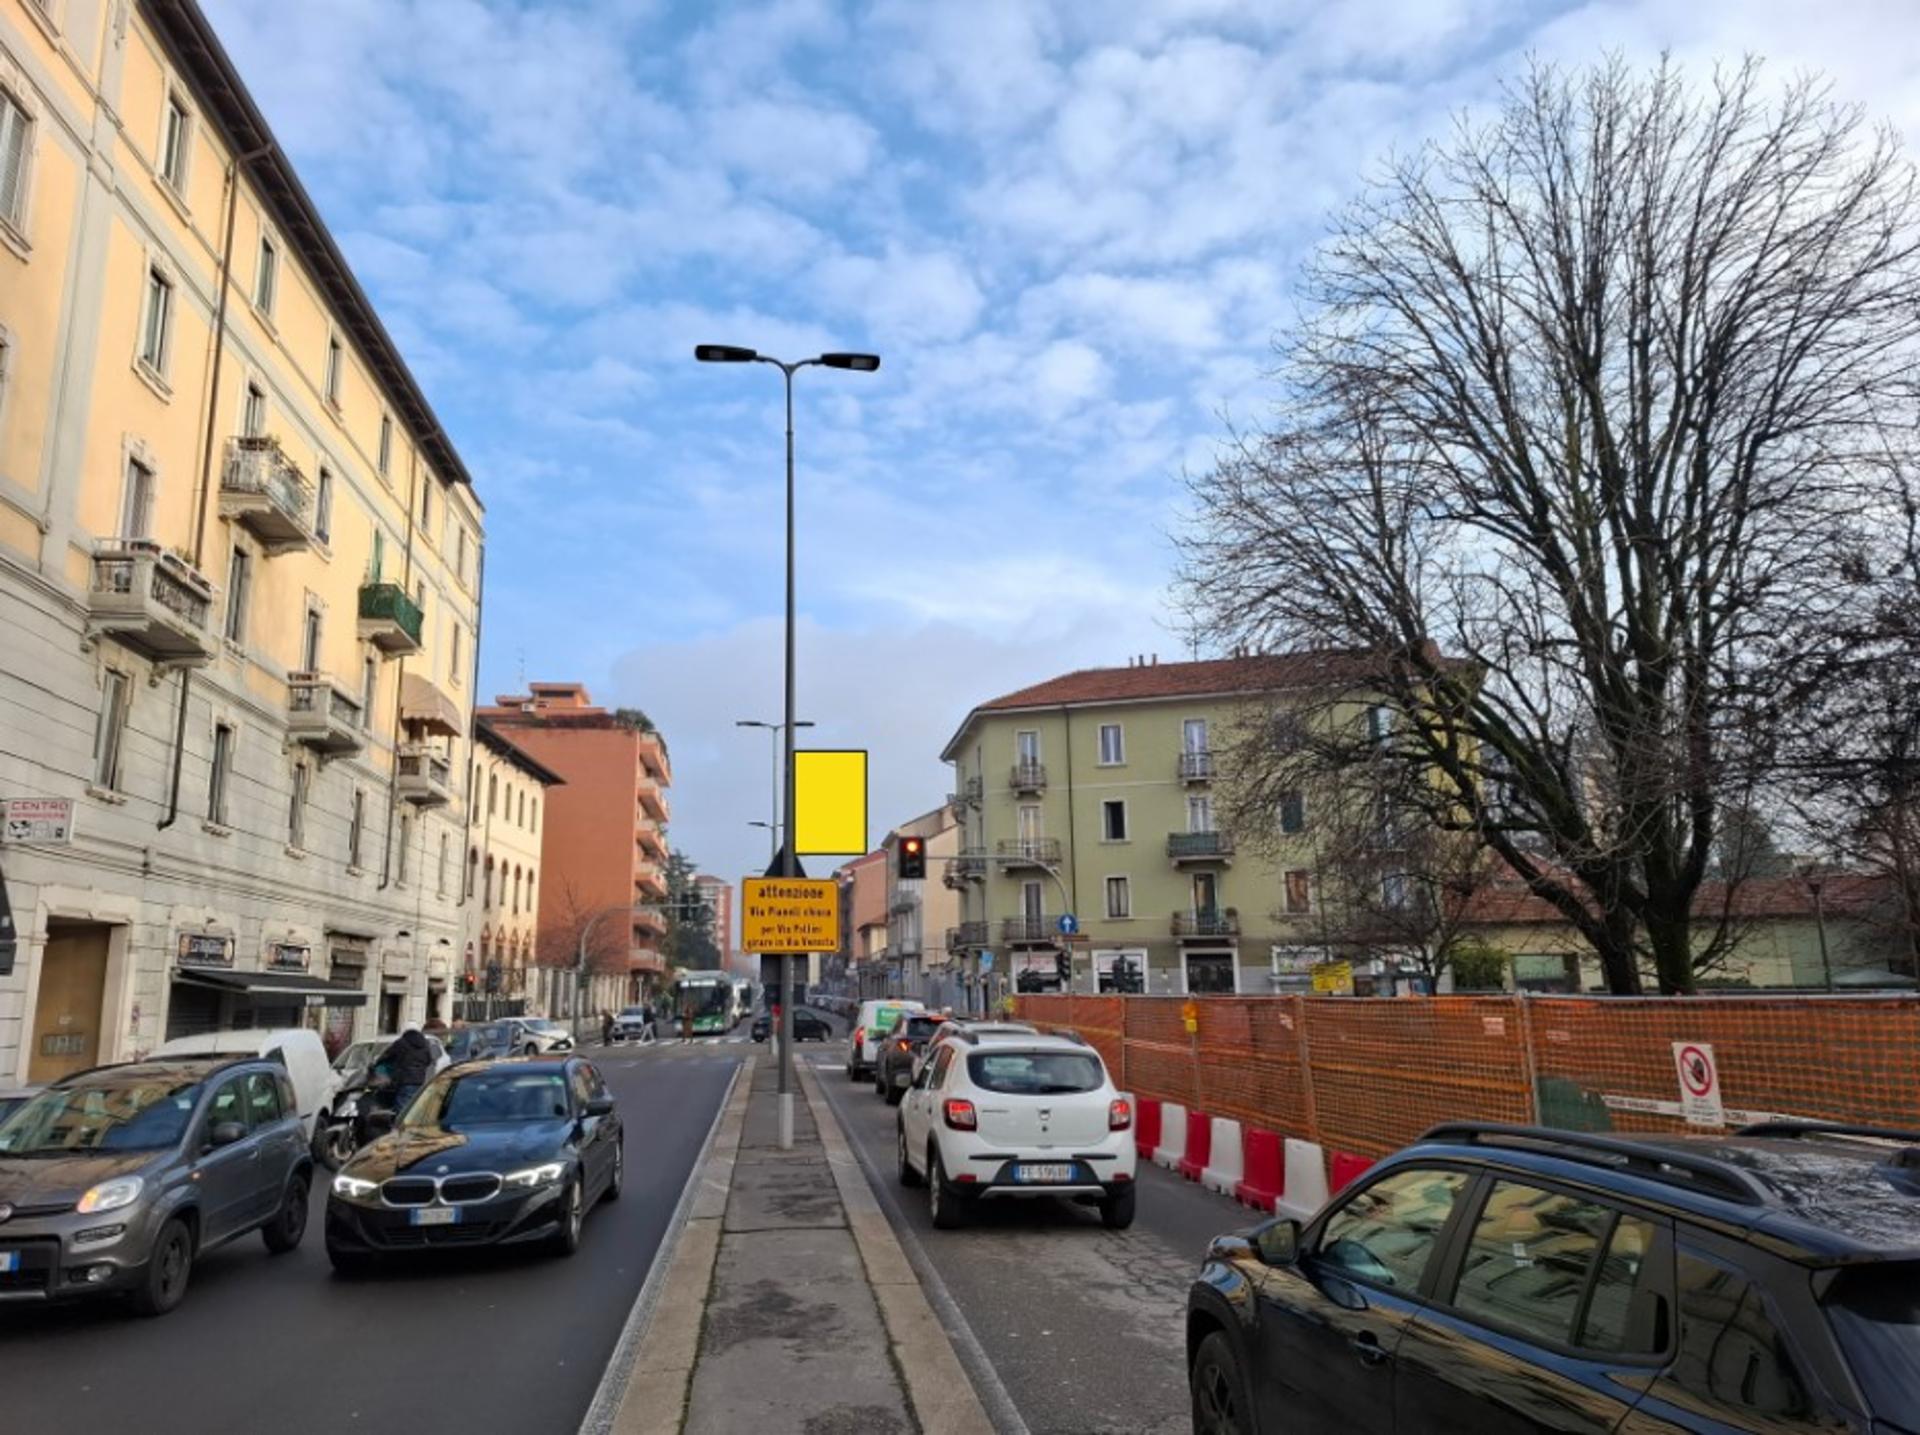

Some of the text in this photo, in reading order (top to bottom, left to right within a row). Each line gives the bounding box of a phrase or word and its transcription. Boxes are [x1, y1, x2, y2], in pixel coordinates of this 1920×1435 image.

[11, 801, 69, 811] CENTRO
[758, 884, 824, 899] attenzione
[750, 906, 765, 917] Via
[776, 923, 791, 934] Via
[786, 936, 800, 947] Via
